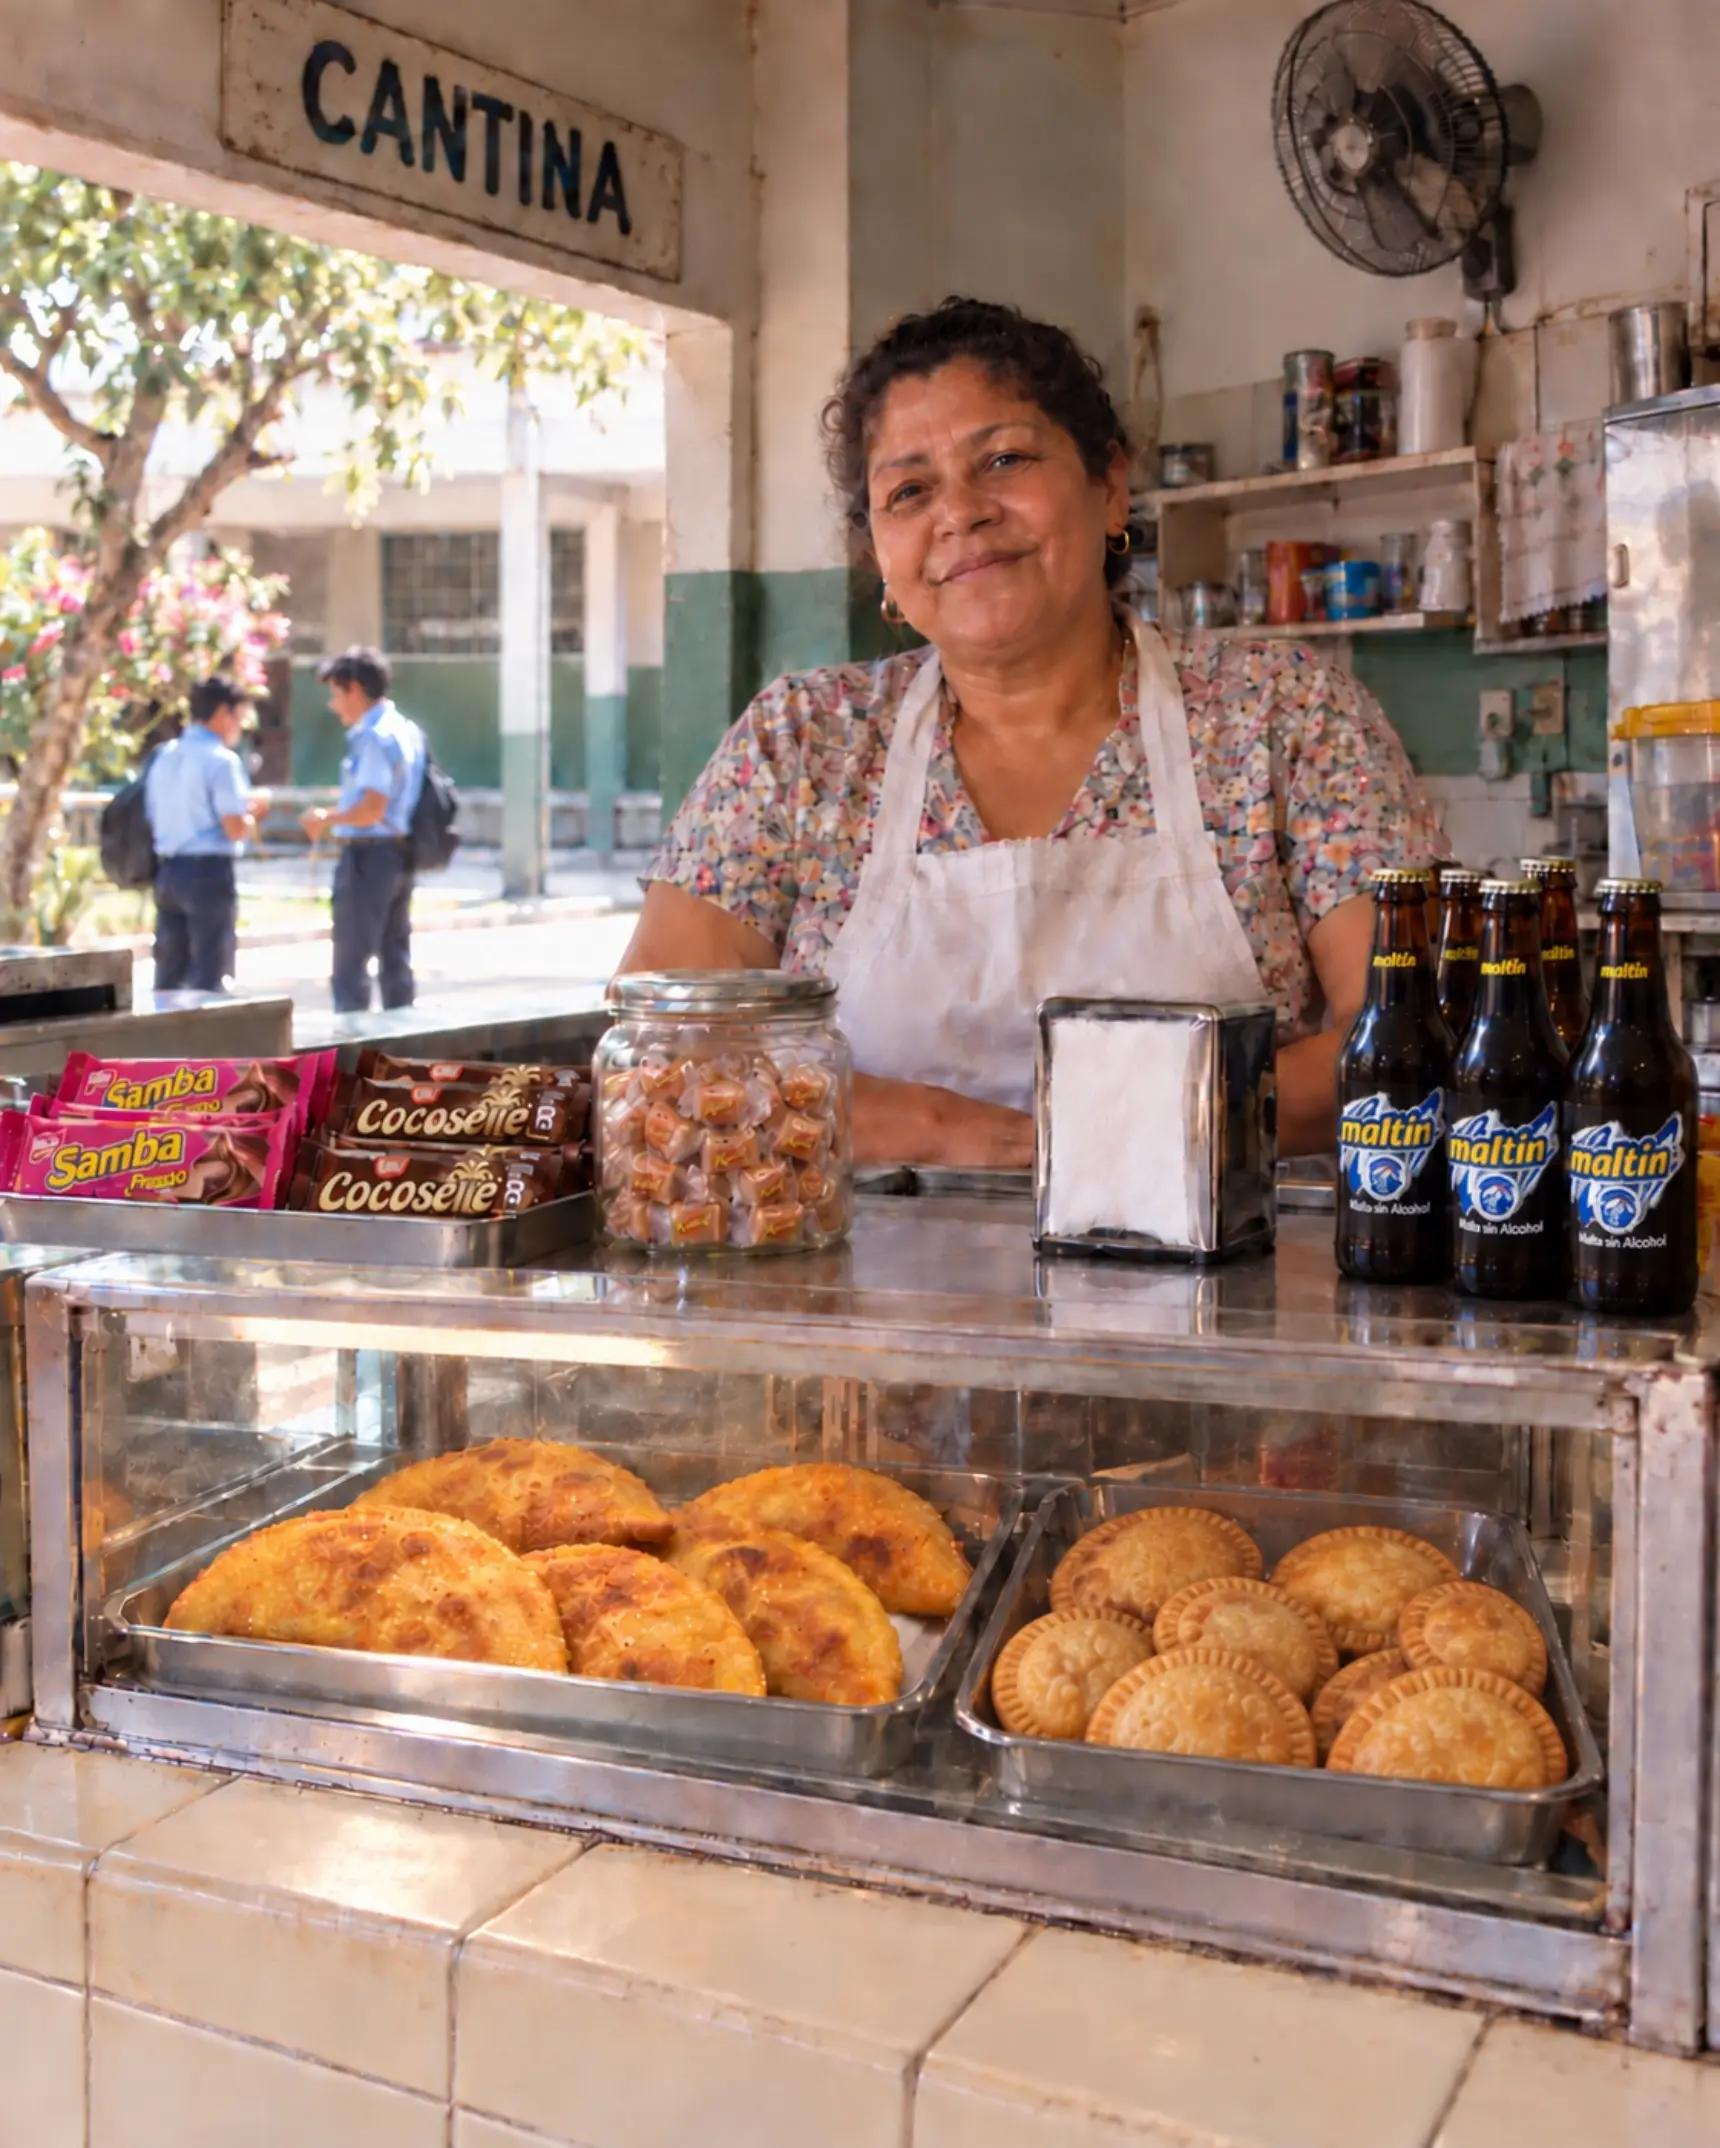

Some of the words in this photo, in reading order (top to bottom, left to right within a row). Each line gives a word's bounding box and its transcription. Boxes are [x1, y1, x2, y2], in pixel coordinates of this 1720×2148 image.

[302, 39, 632, 236] CANTINA
[1600, 961, 1648, 979] maltin
[106, 1066, 215, 1109] Samba
[1342, 1115, 1431, 1147] maltin
[48, 1131, 182, 1187] Samba
[1450, 1132, 1545, 1166] maltin
[1571, 1142, 1669, 1178] maltin
[1391, 1200, 1431, 1215] Alcohol
[1500, 1219, 1544, 1235] Alcohol
[1623, 1231, 1667, 1249] Alcohol
